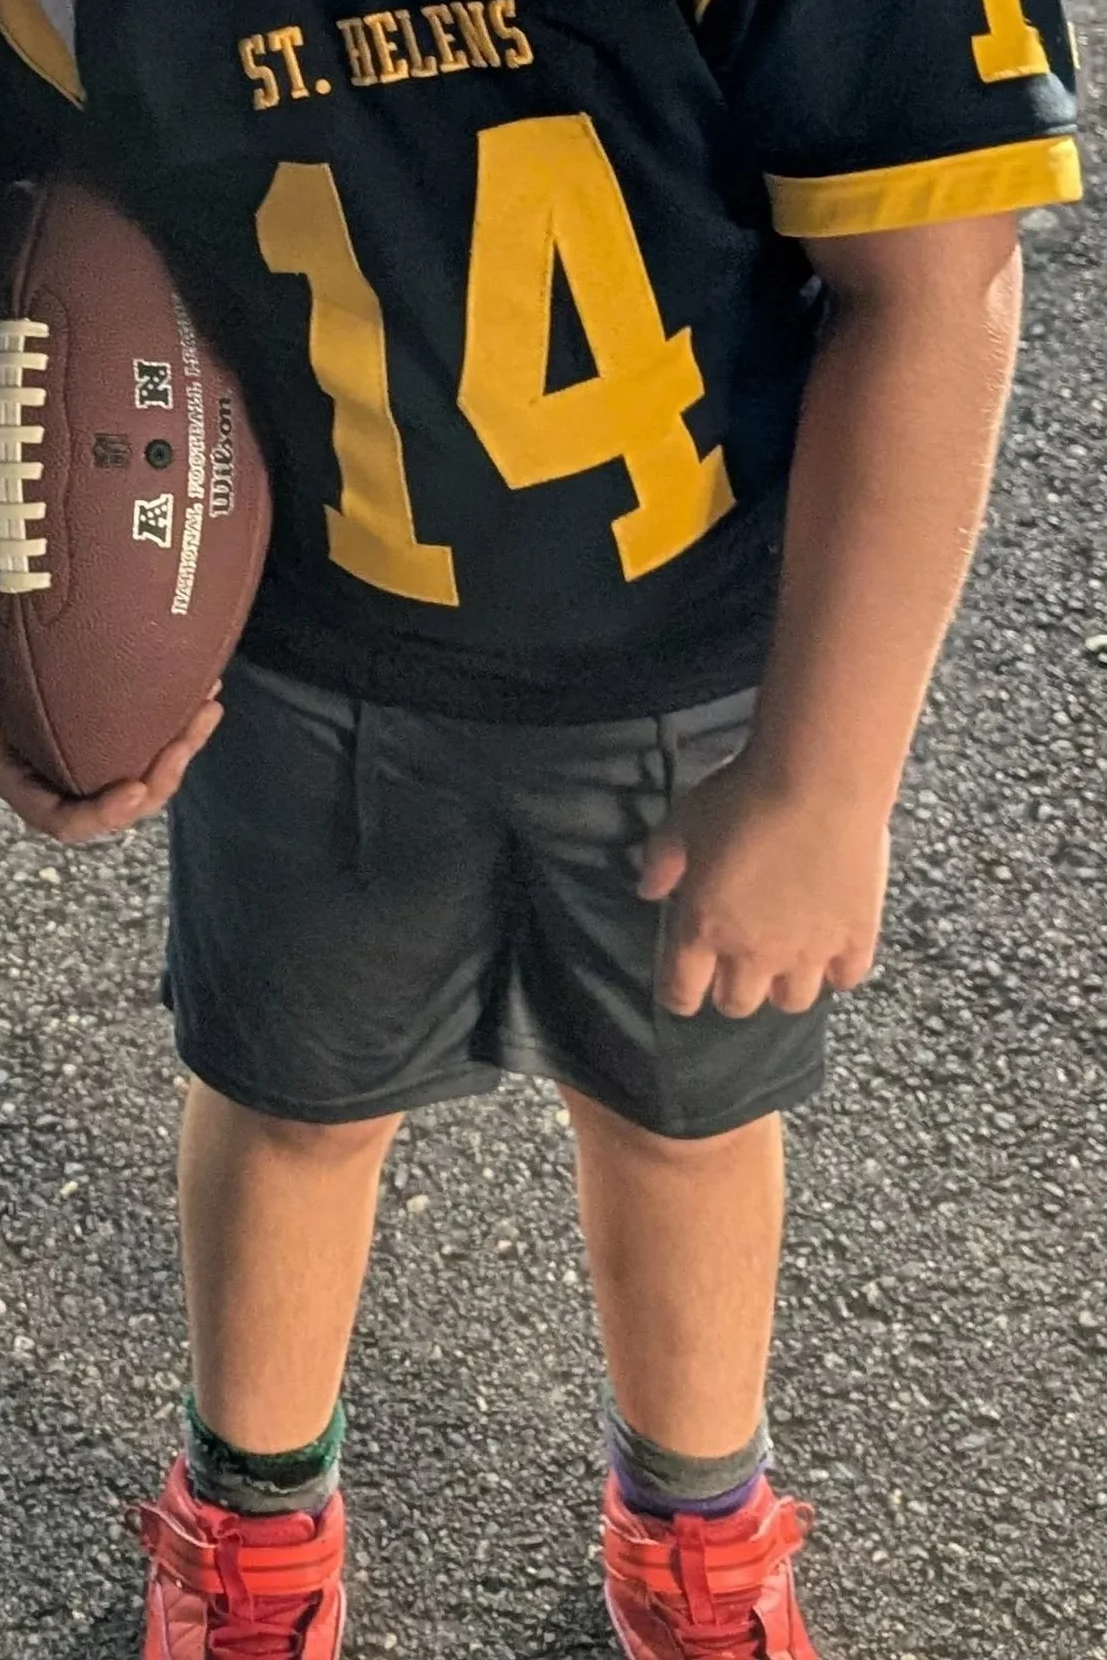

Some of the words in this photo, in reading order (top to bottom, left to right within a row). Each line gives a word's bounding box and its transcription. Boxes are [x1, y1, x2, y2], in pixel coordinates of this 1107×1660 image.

[238, 26, 331, 110] ST.
[255, 112, 737, 608] 14
[209, 397, 235, 518] Wilson
